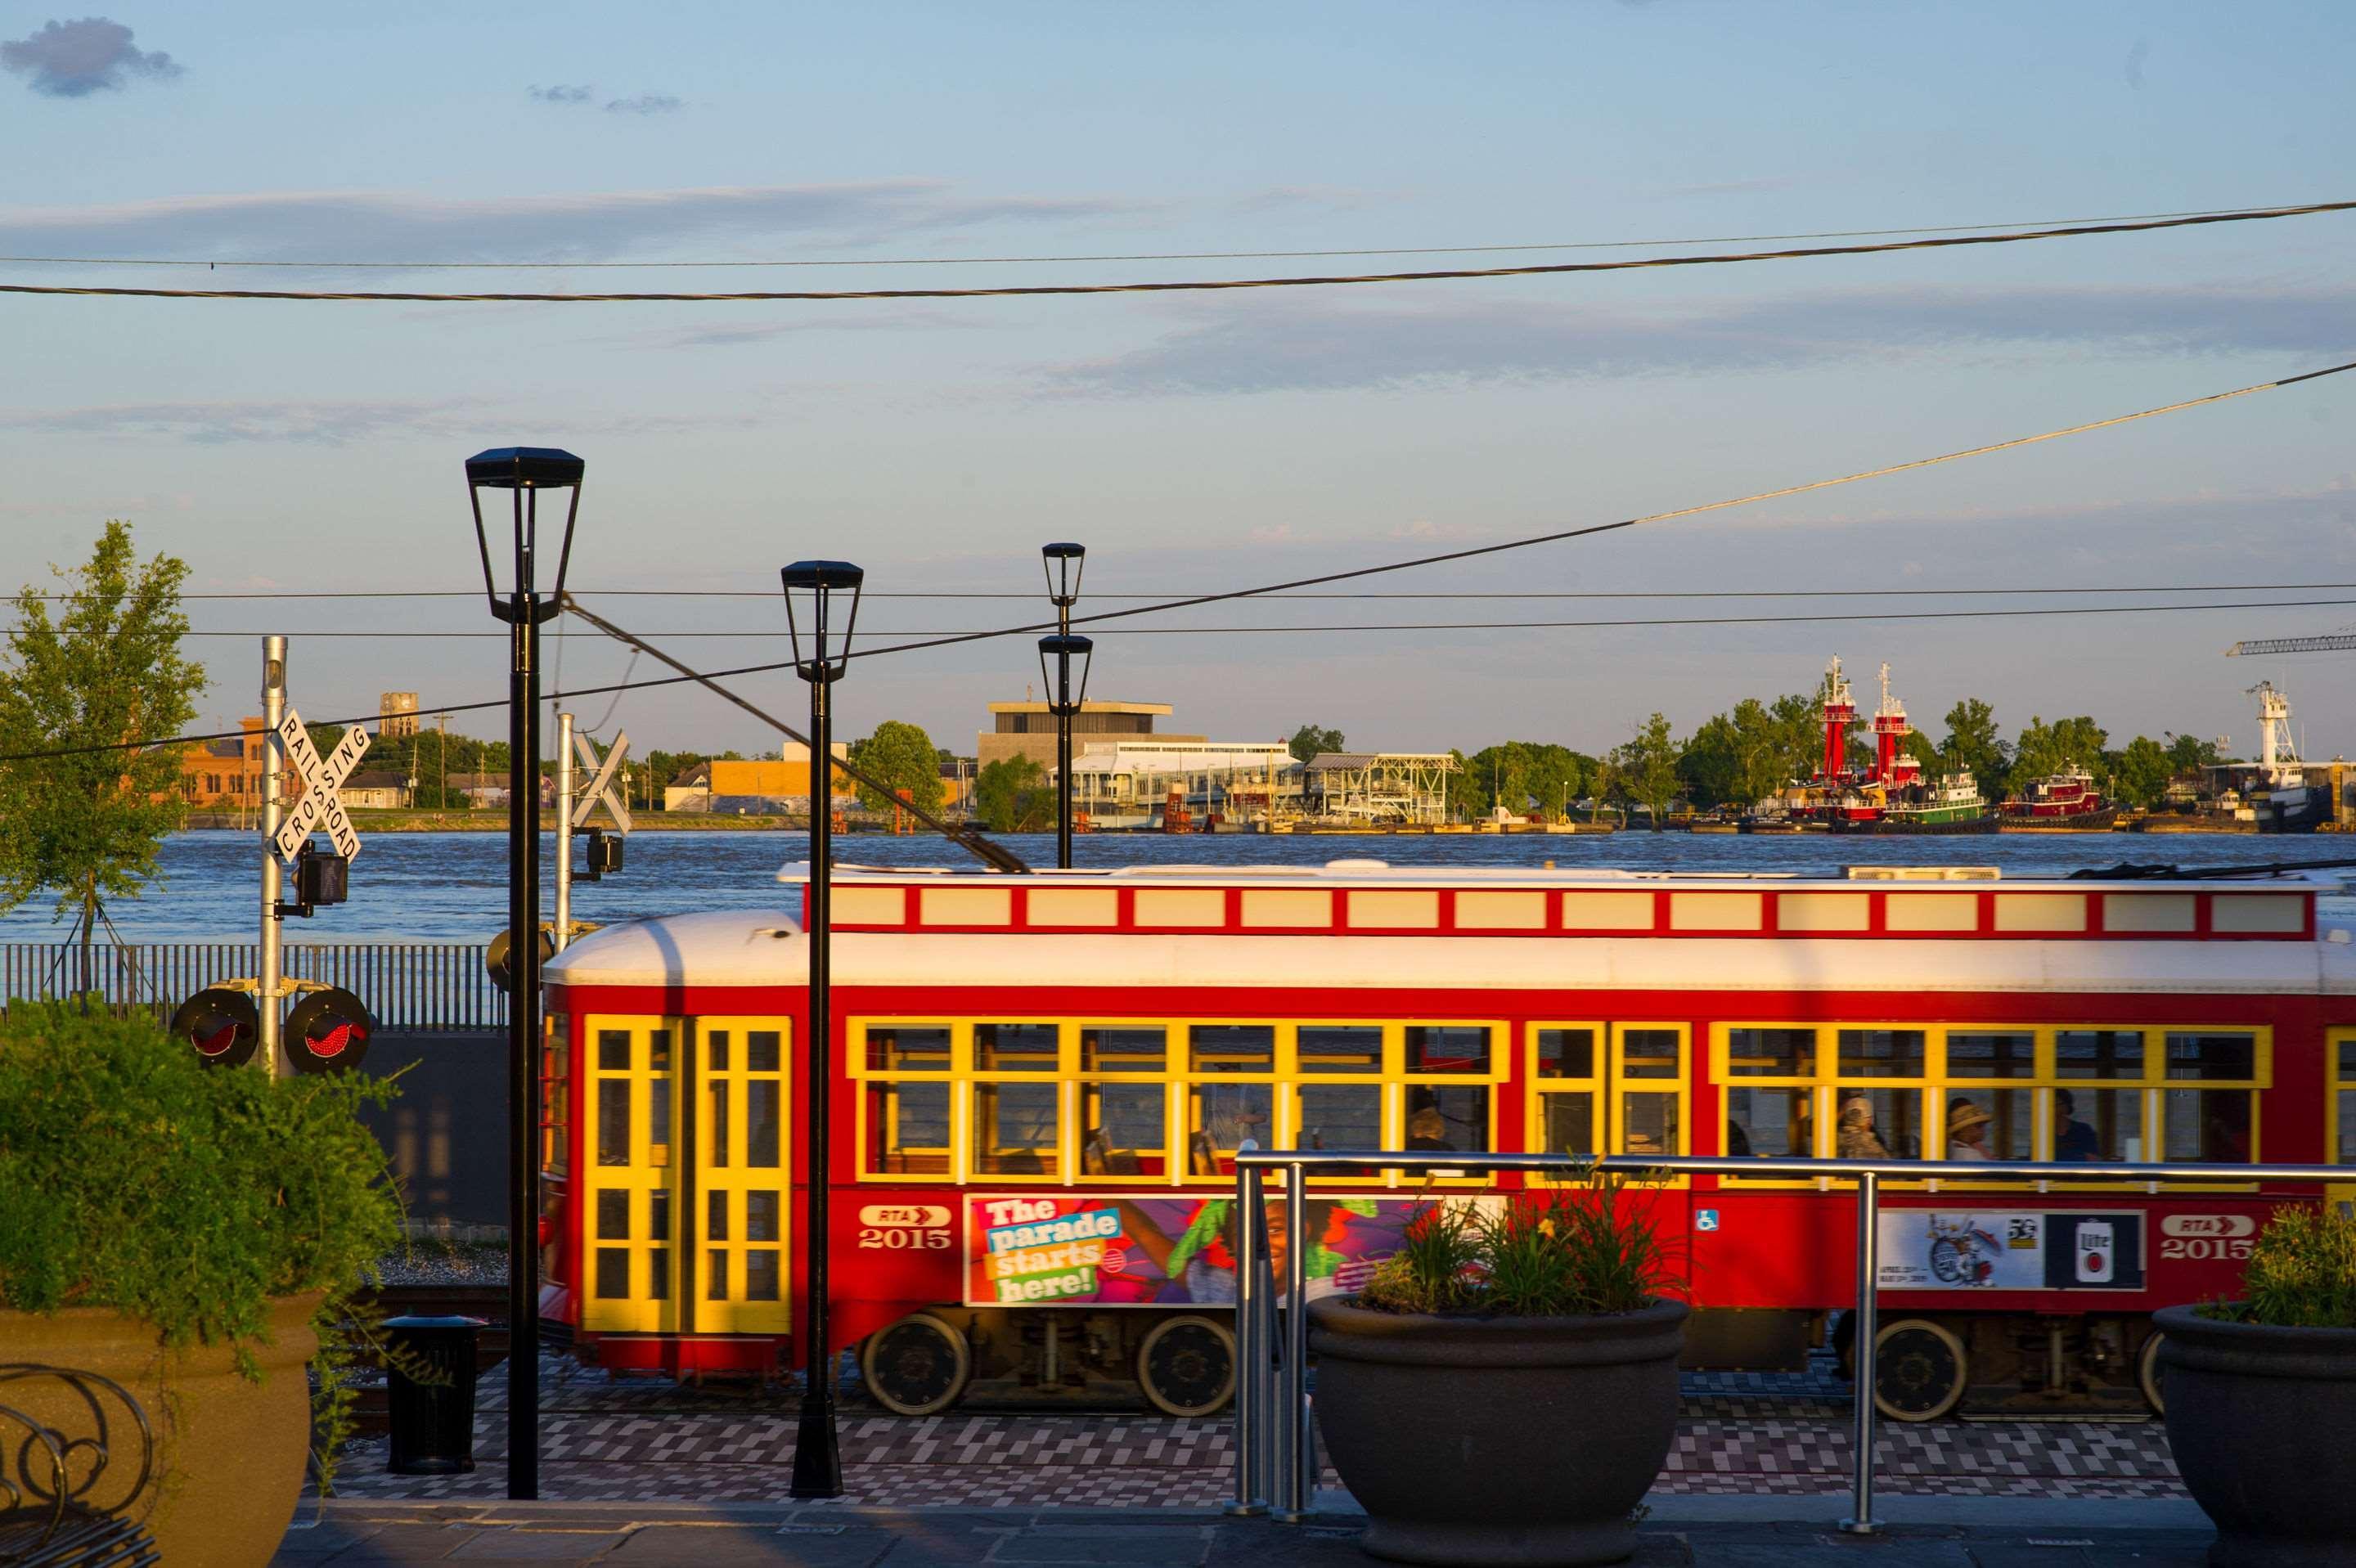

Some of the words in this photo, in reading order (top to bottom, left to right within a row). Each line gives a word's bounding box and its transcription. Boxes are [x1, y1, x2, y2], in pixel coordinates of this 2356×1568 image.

[282, 728, 365, 852] CROSSING
[284, 718, 316, 782] RAIL
[323, 797, 355, 859] ROAD
[1928, 791, 1936, 801] H
[2037, 784, 2048, 796] M
[877, 1209, 910, 1222] RTA
[986, 1199, 1056, 1226] The
[990, 1213, 1118, 1256] parade
[2178, 1219, 2214, 1233] RTA
[859, 1229, 951, 1249] 2015
[2080, 1233, 2110, 1251] Lite
[2160, 1238, 2255, 1260] 2015
[996, 1242, 1102, 1278] starts
[997, 1268, 1093, 1302] here!
